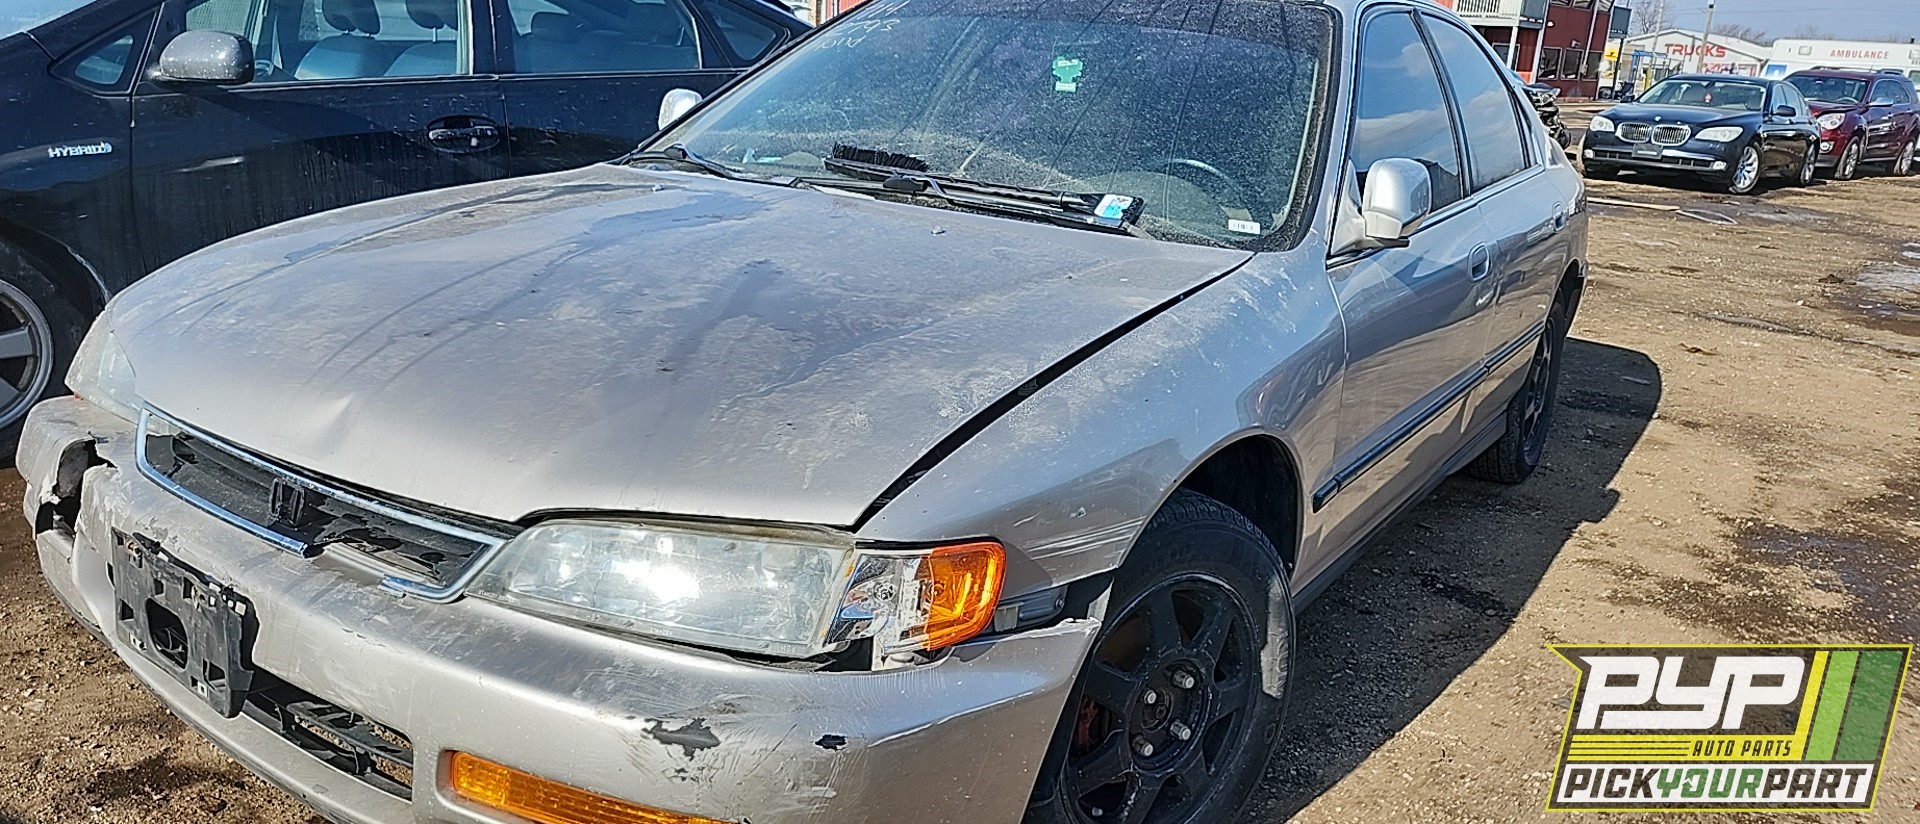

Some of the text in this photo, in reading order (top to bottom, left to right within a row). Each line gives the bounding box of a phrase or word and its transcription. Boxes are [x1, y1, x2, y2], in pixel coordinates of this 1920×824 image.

[1664, 43, 1727, 58] TRUCKS
[1829, 49, 1890, 60] AMBULANCE
[47, 143, 105, 158] HYBRID
